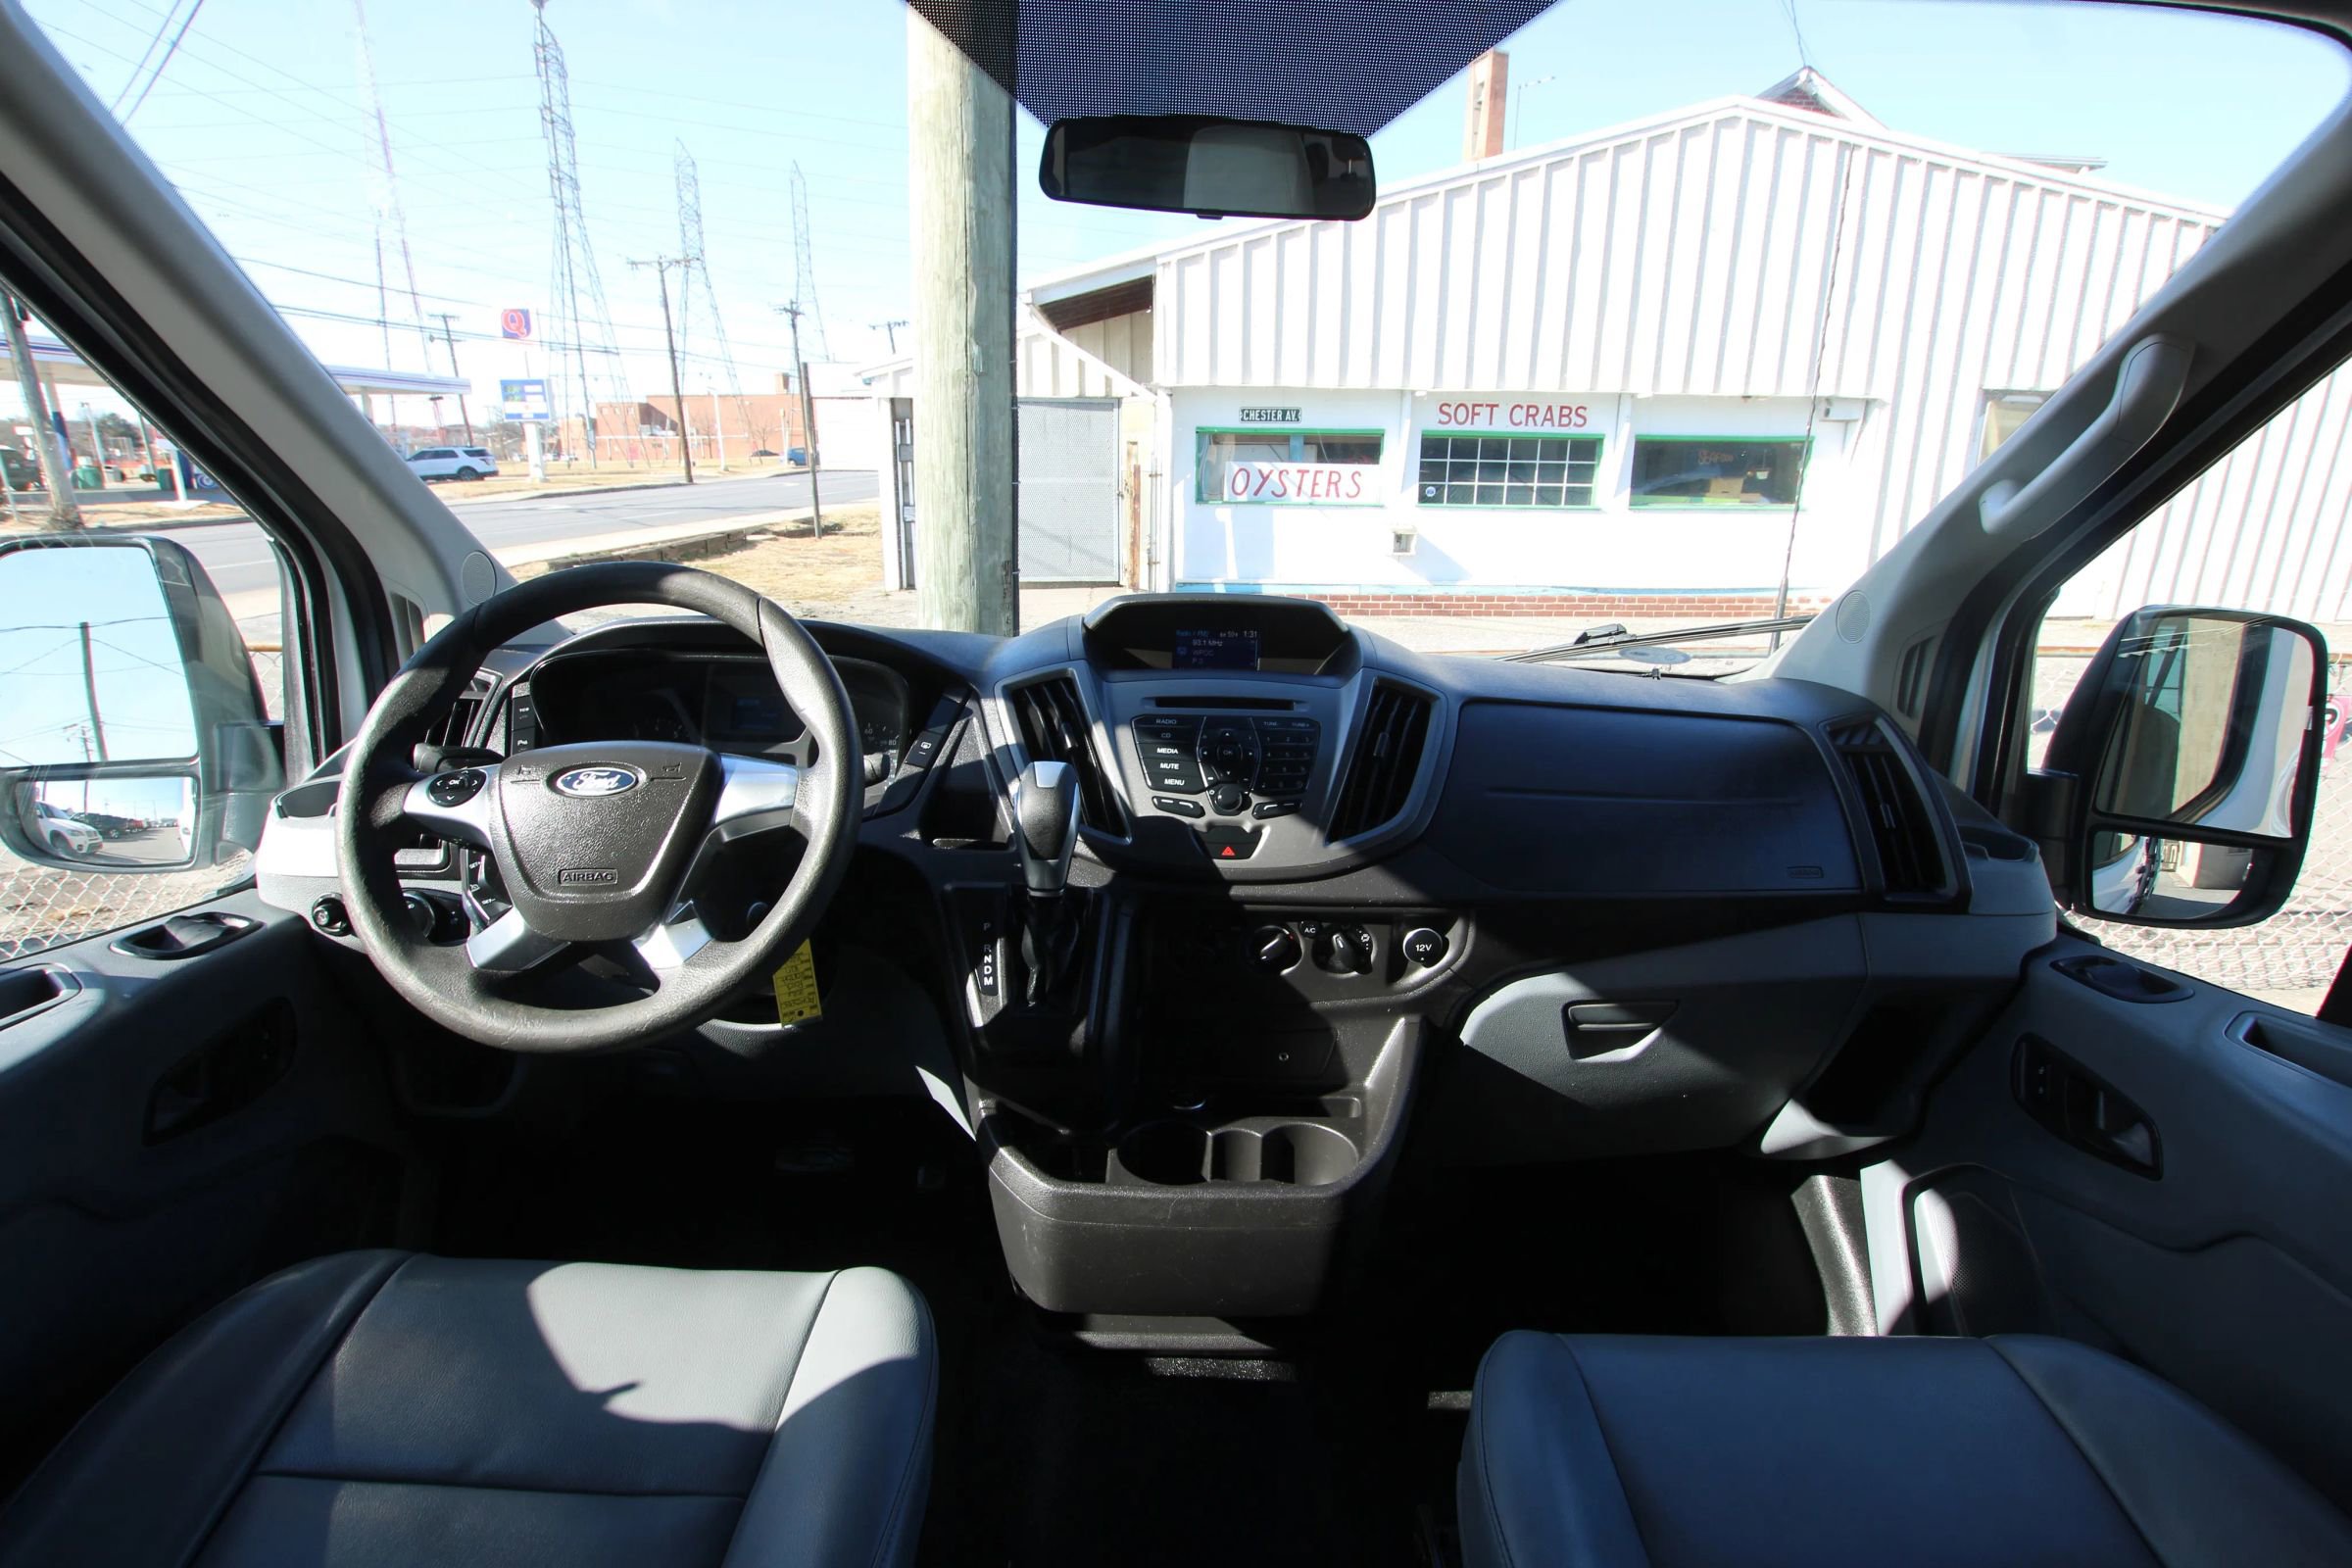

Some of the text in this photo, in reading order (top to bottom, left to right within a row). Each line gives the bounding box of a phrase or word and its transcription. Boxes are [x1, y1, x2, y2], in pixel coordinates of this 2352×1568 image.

[501, 311, 527, 338] Q
[1243, 410, 1283, 421] CHESTER
[1438, 402, 1588, 428] SOFT CRABS
[1231, 467, 1361, 498] OYSTERS
[572, 770, 621, 791] Ford
[563, 871, 613, 882] AIRBAG
[1415, 944, 1433, 953] 12V
